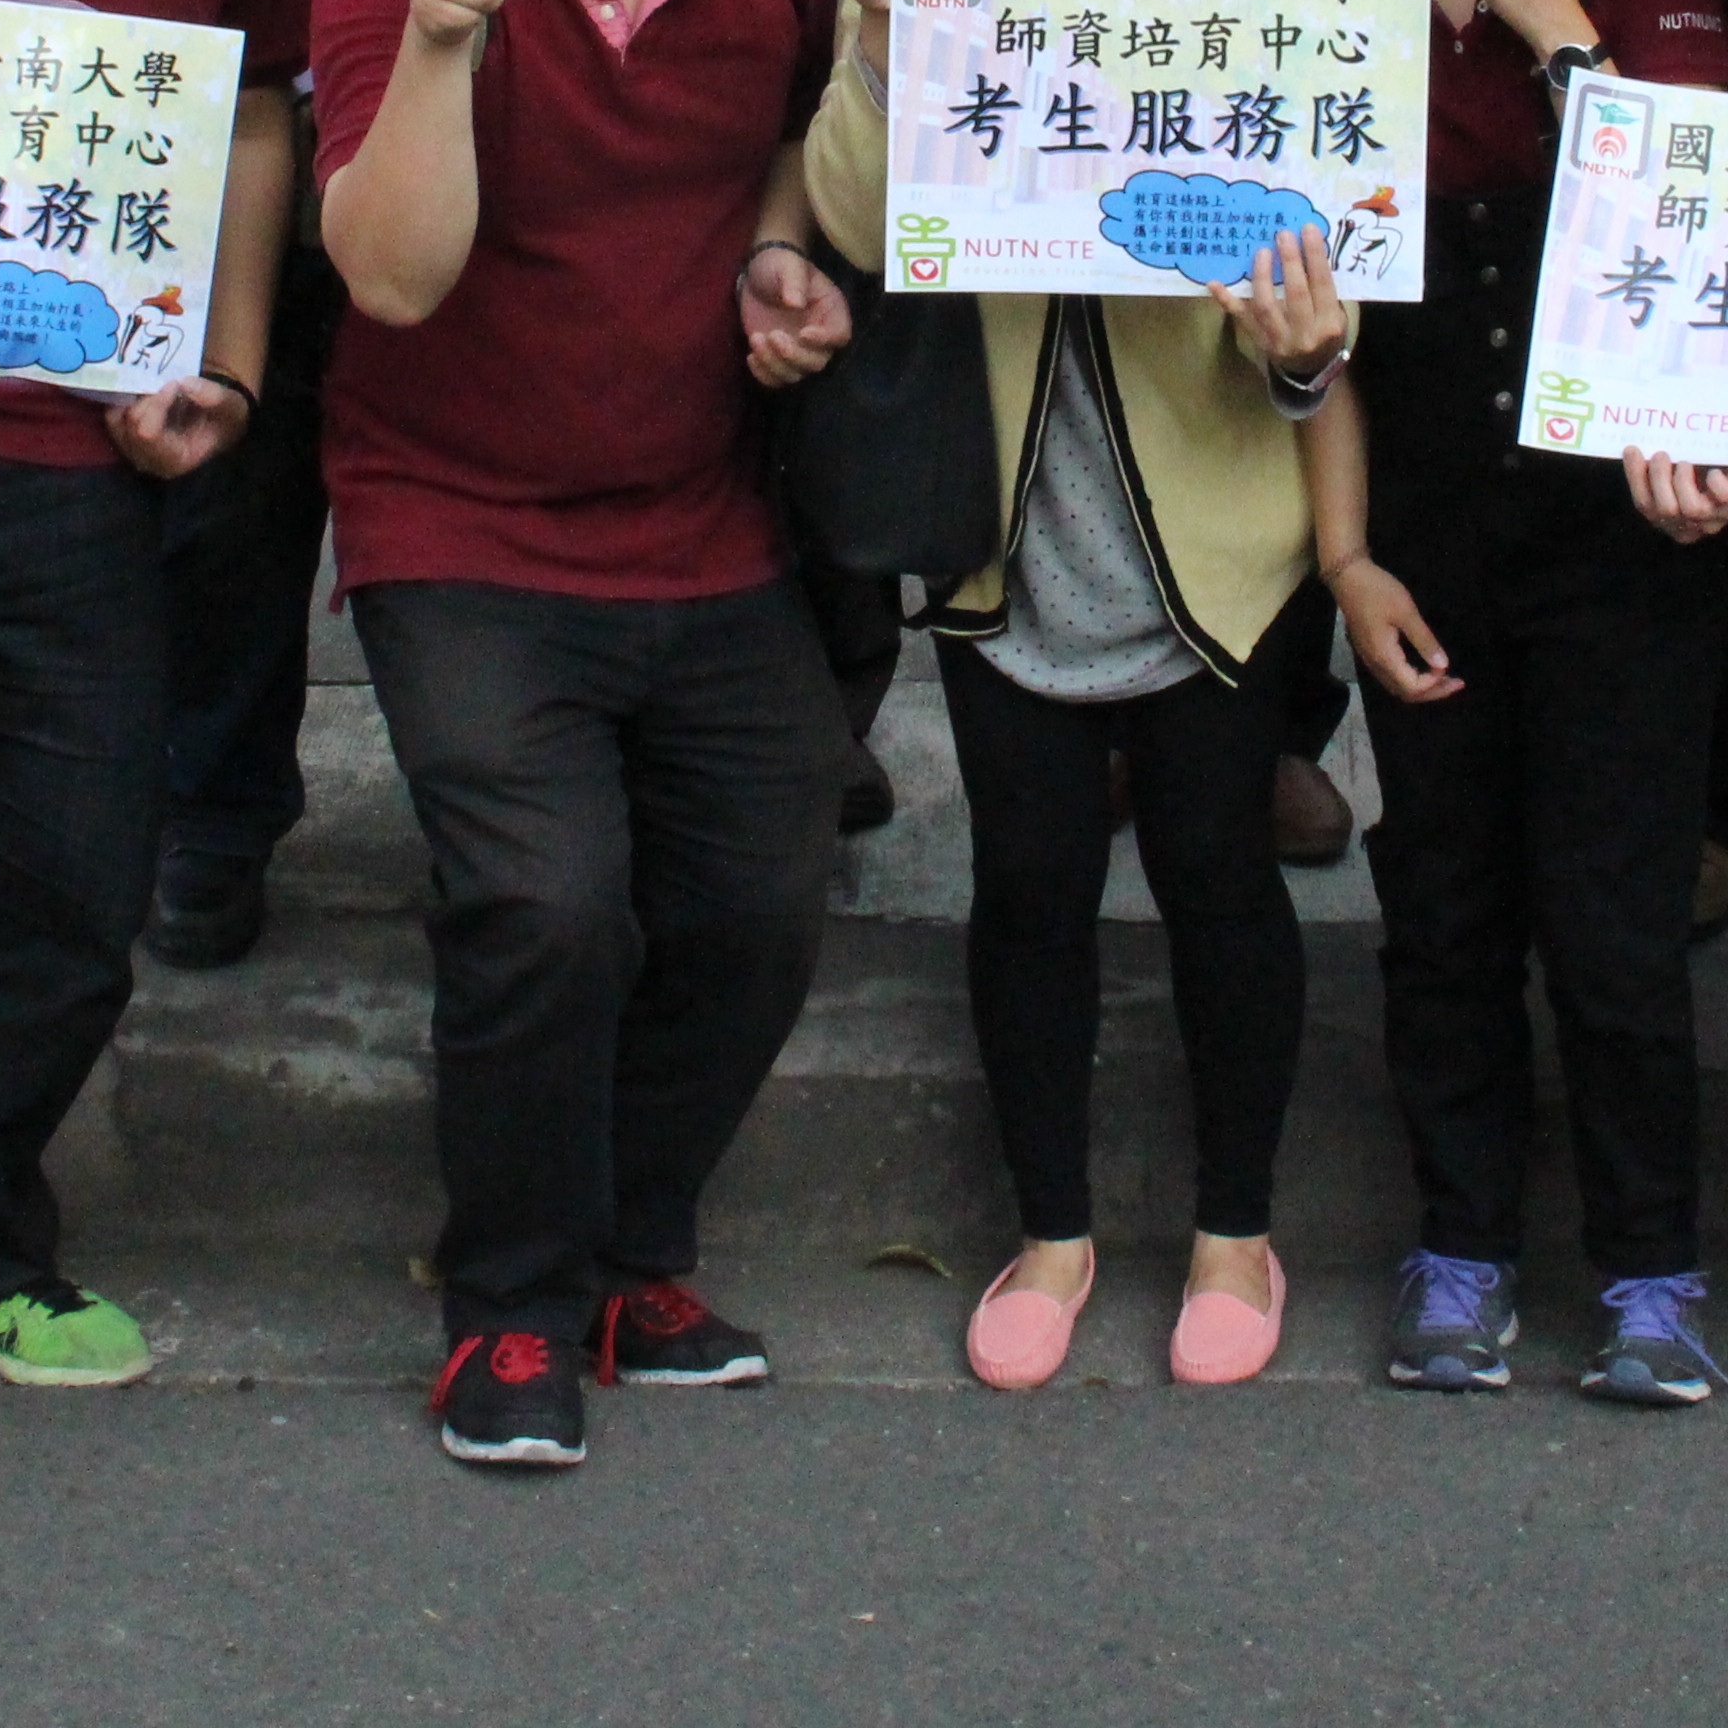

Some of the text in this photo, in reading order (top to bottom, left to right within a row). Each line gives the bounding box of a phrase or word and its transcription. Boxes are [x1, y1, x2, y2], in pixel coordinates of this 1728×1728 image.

[995, 7, 1370, 71] 師資培育中心
[944, 73, 1387, 165] 考生服務隊
[1582, 162, 1631, 178] NUTN
[1133, 225, 1278, 241] 攜手共創這未來人生
[964, 238, 1094, 259] NUTN CTE
[1603, 404, 1677, 429] NUTN
